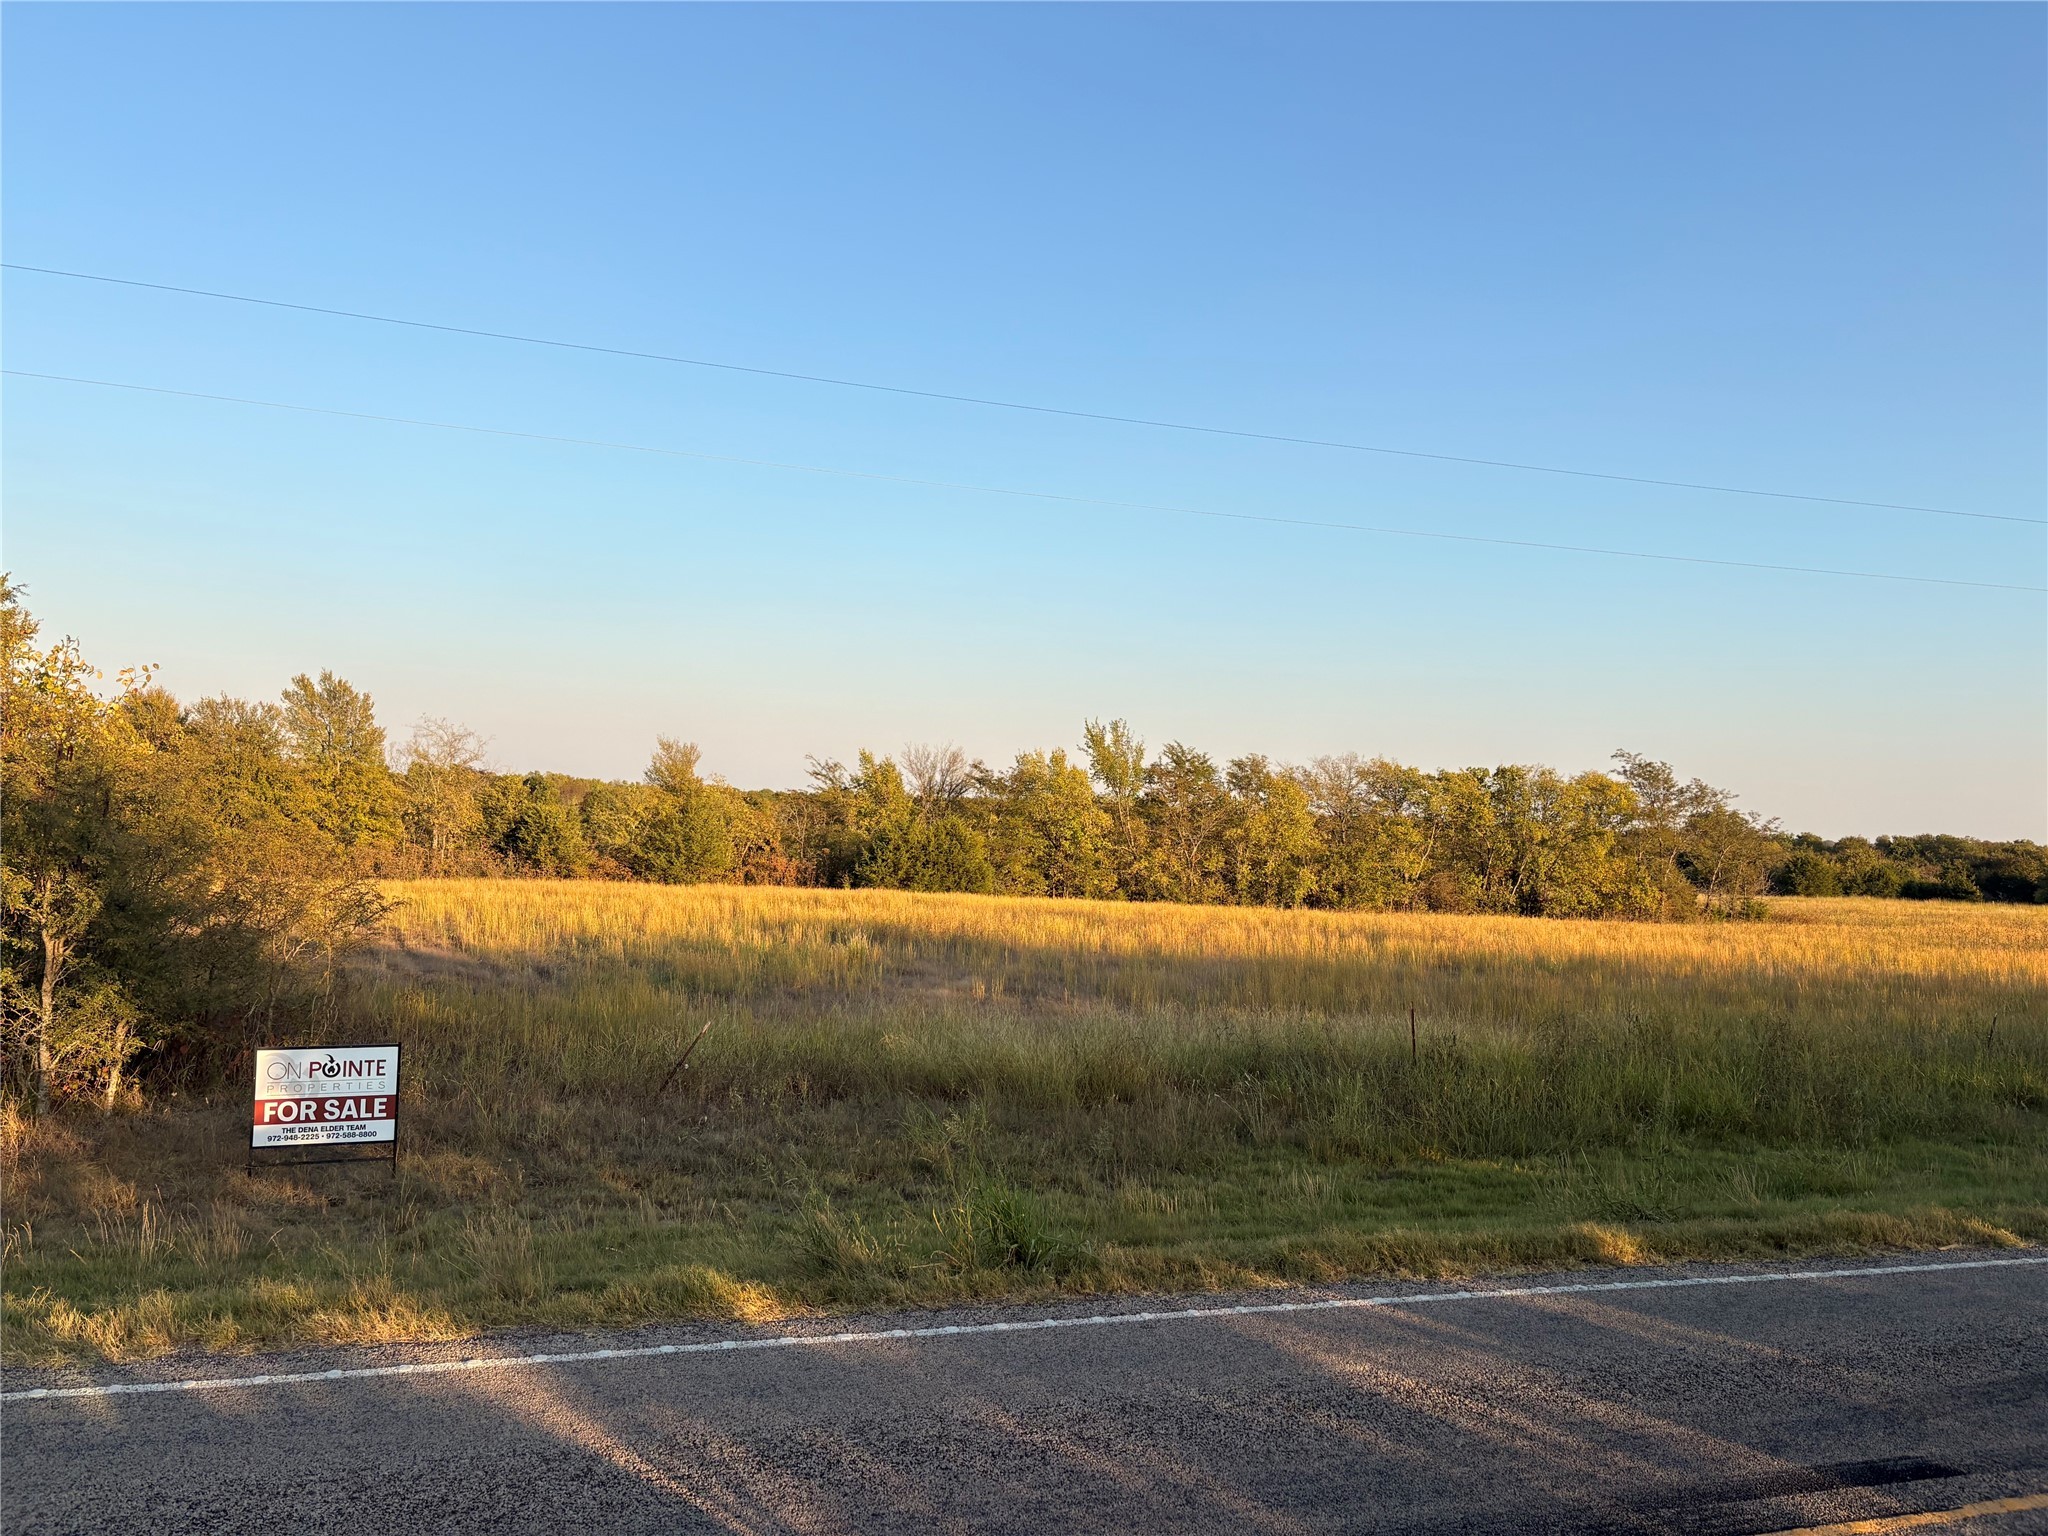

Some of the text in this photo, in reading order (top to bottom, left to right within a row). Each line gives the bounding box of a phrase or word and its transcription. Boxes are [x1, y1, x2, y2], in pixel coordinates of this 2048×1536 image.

[267, 1059, 387, 1080] ON POINTE
[266, 1080, 386, 1093] PROPERTIES
[263, 1097, 387, 1123] FOR SALE
[267, 1131, 377, 1142] 972-948-2225 972-588-8800
